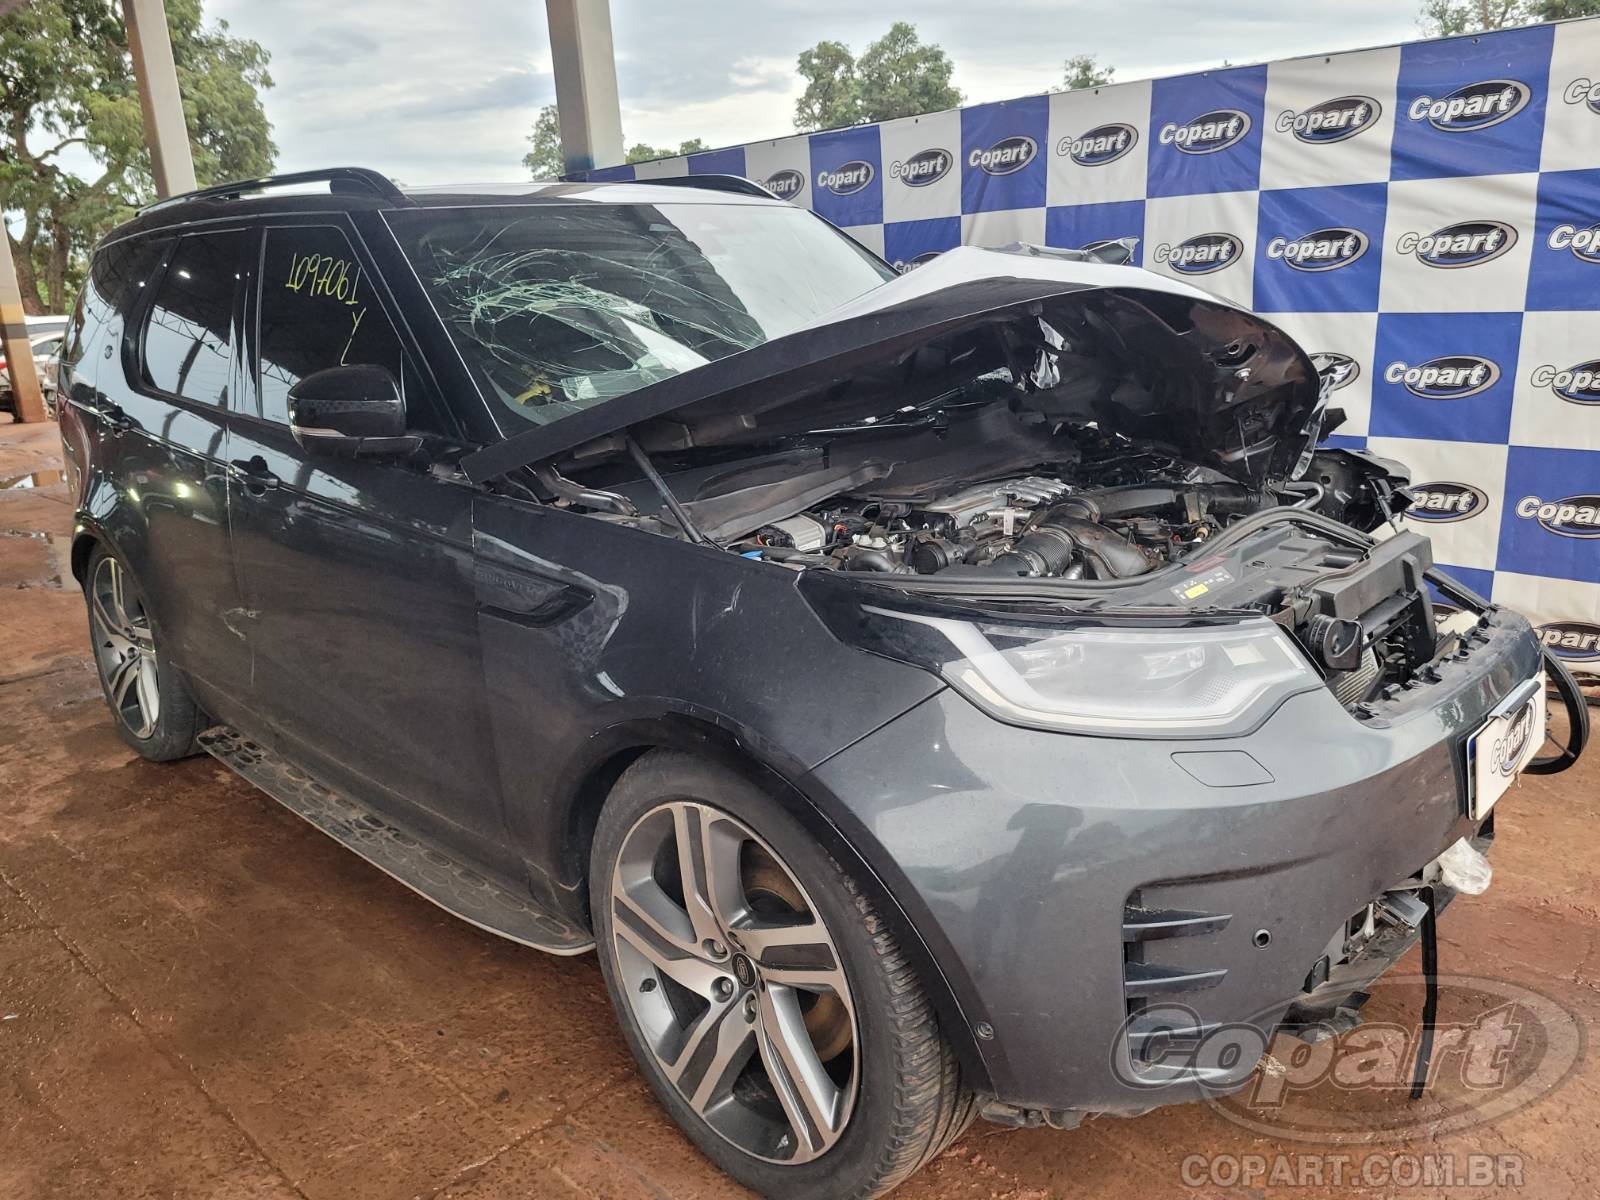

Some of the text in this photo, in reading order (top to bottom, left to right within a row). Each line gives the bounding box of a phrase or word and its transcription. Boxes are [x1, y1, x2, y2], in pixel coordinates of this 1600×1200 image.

[1408, 81, 1518, 124] Copart
[1159, 111, 1241, 145] Copart
[1275, 102, 1368, 138] Copart
[967, 141, 1029, 169] Copart
[1056, 125, 1128, 158] Copart
[817, 164, 868, 188] Copart
[889, 151, 945, 177] Copart
[1153, 235, 1233, 266] Copart
[1265, 232, 1358, 266] Copart
[1396, 223, 1505, 260] Copart
[1547, 224, 1600, 255] Cop
[285, 252, 361, 305] 1097061
[1384, 360, 1488, 389] Copart
[1530, 364, 1600, 395] Copa
[1405, 490, 1474, 513] part
[1515, 495, 1600, 527] Copa
[1491, 703, 1534, 775] Copart
